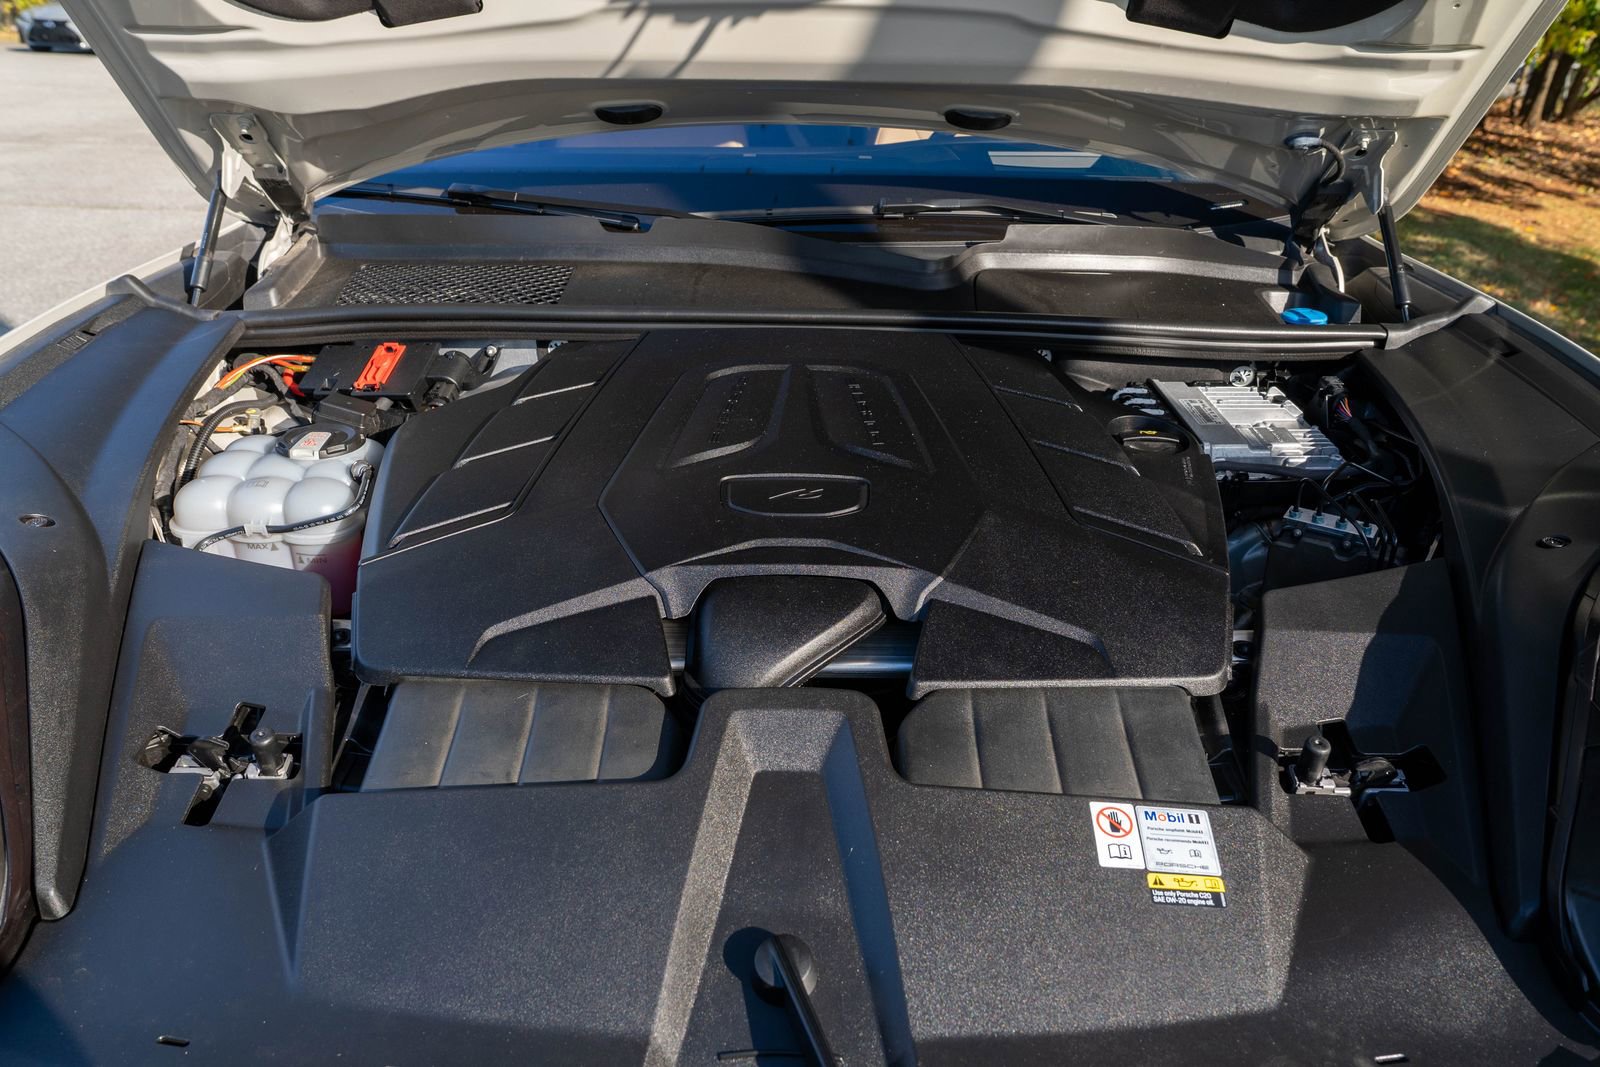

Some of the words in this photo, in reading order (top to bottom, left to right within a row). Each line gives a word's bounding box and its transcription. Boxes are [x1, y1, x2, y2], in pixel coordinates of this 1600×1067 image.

[1144, 810, 1185, 823] Mobil
[1188, 813, 1201, 825] 1
[1155, 861, 1210, 870] PORSCHE
[1176, 890, 1199, 899] Porsche
[1165, 896, 1187, 904] 0W-20
[1186, 898, 1206, 906] engine
